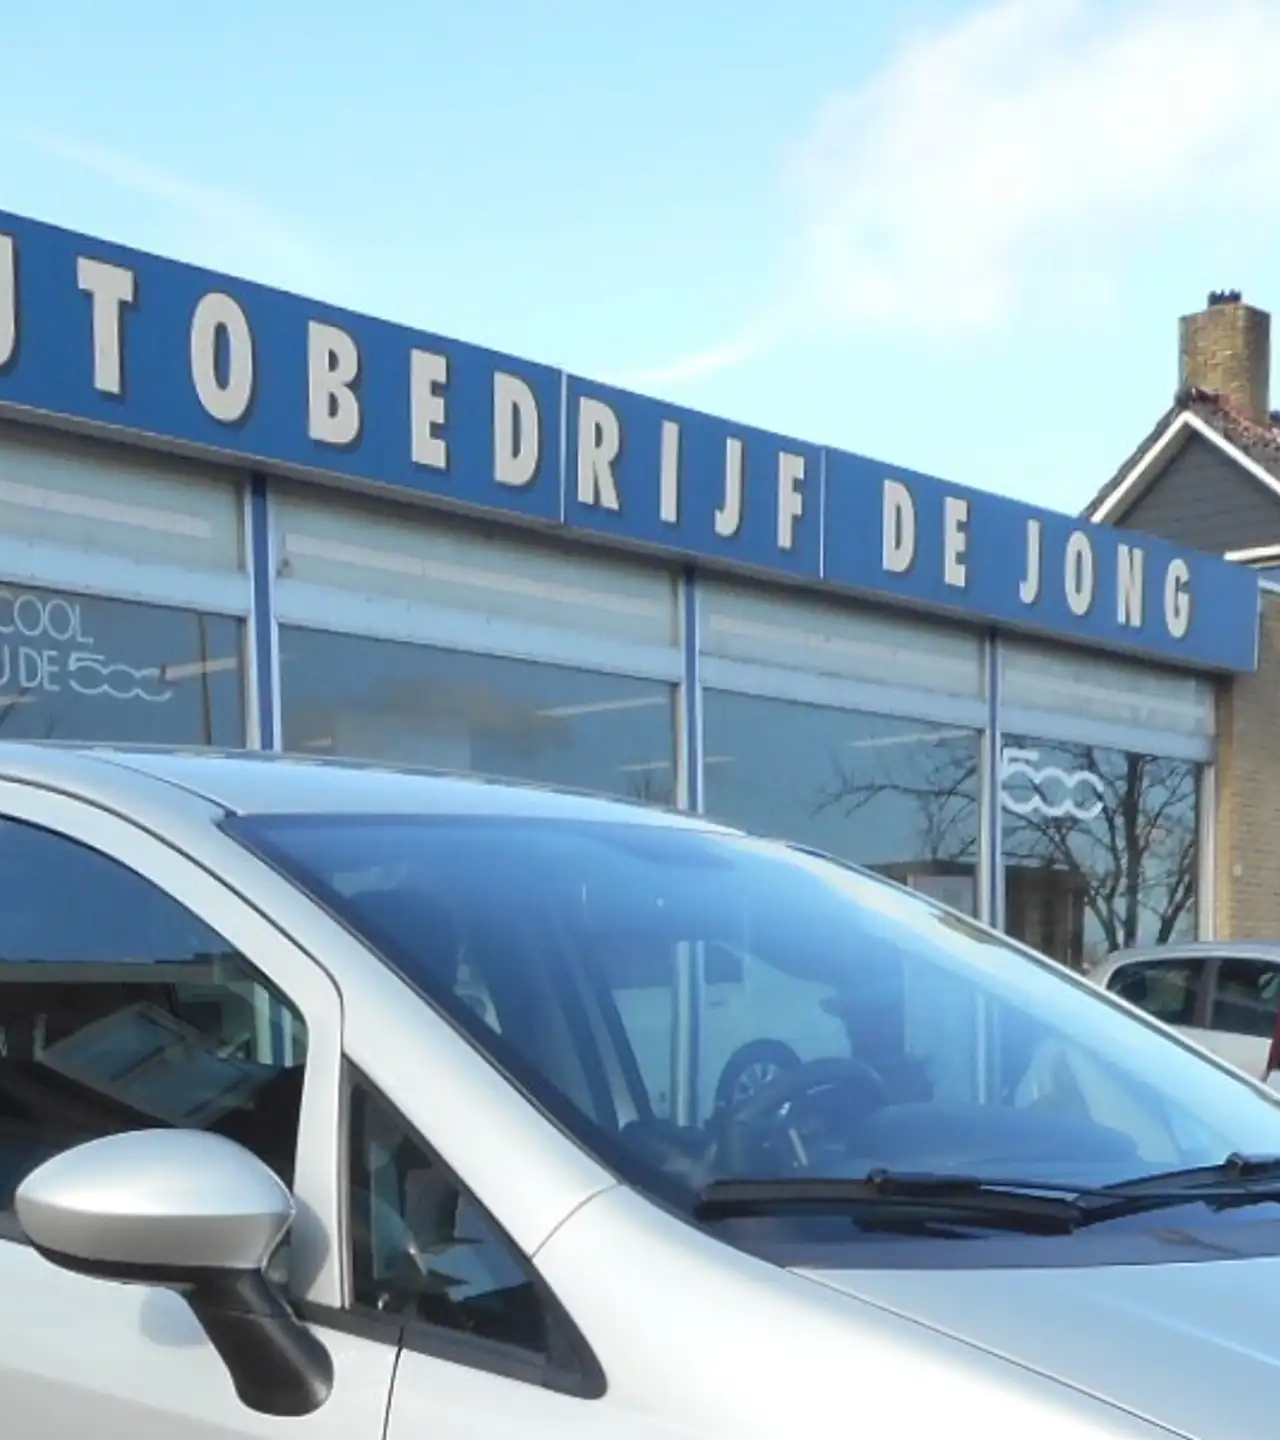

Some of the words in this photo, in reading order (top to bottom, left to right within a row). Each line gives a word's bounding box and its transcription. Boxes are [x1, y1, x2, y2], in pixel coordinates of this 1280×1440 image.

[882, 478, 968, 588] DE
[1019, 518, 1191, 639] JONG
[23, 649, 62, 693] DE
